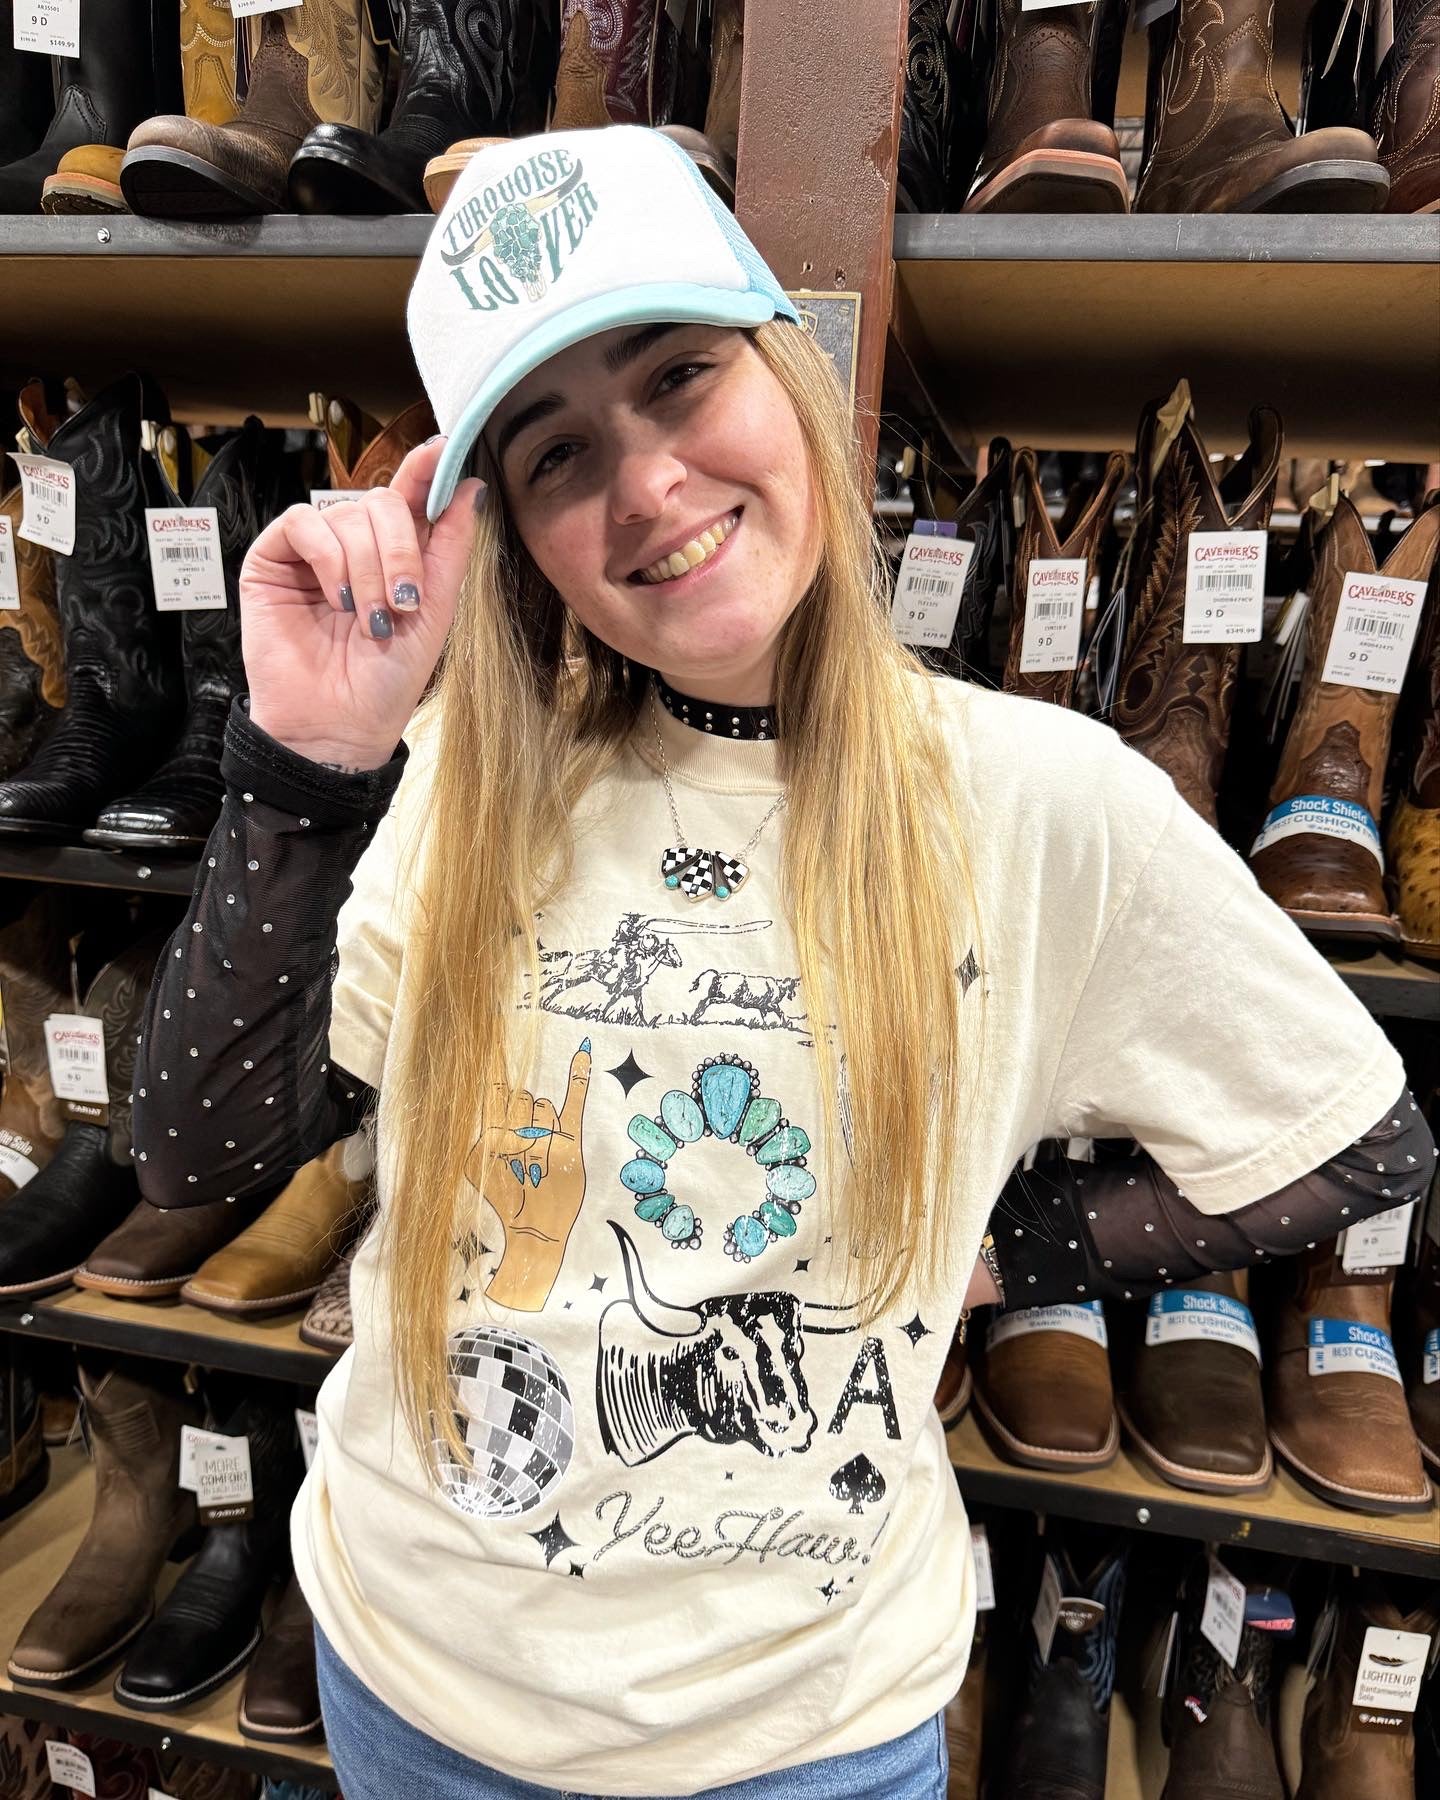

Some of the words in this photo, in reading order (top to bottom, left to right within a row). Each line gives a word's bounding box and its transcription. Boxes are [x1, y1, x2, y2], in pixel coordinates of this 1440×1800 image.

[31, 15, 37, 25] 9
[40, 16, 48, 26] D
[442, 149, 574, 253] TURQUOISE
[1194, 545, 1260, 562] CAVENDER'S
[1347, 584, 1416, 607] CAVENDER'S
[908, 610, 916, 619] 9
[917, 612, 925, 620] D
[1205, 609, 1213, 618] 9
[1215, 609, 1224, 618] D
[1038, 637, 1044, 647] 9
[1045, 637, 1053, 646] D
[1347, 651, 1357, 661] 9
[1359, 653, 1369, 662] D
[1290, 799, 1330, 812] Shock
[1331, 801, 1368, 825] Shield
[1293, 814, 1362, 832] CUSHION
[1183, 1295, 1218, 1310] Shock
[1016, 1305, 1073, 1321] CUSHION
[1348, 1326, 1382, 1347] Shock
[1332, 1347, 1353, 1358] BEST
[827, 1337, 902, 1440] A
[204, 1457, 240, 1473] MORE
[593, 1490, 706, 1562] Yee
[1362, 1669, 1401, 1684] LIGHTEN
[1402, 1674, 1417, 1686] UP
[1368, 1716, 1403, 1726] ARIAT
